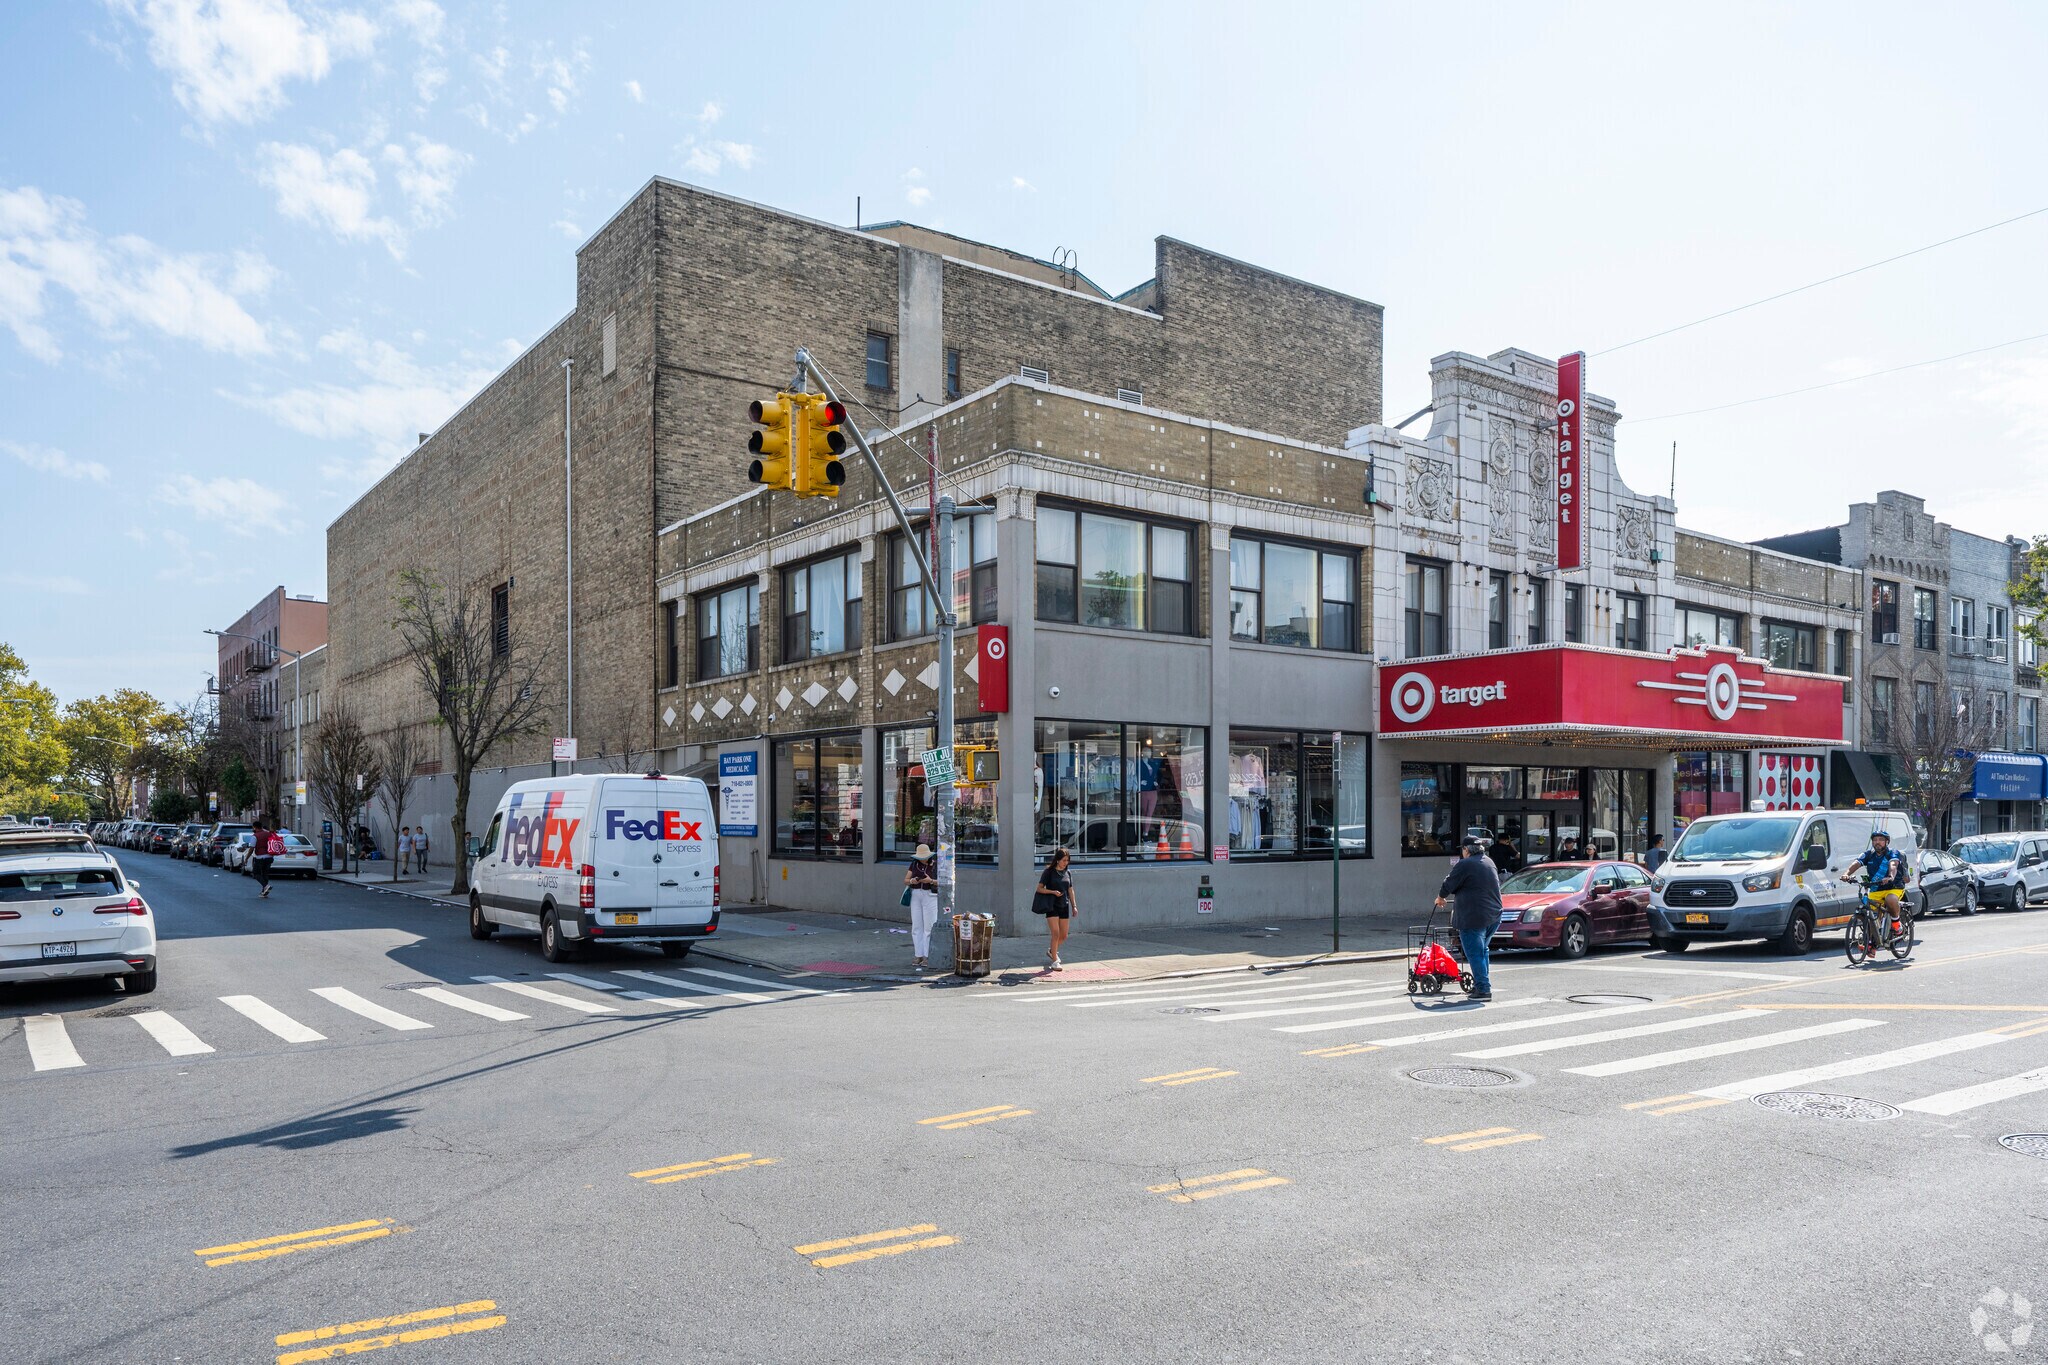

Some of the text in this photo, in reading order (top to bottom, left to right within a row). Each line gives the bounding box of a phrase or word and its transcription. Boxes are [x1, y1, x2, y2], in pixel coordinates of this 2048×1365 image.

[1559, 421, 1573, 524] target
[1440, 680, 1507, 707] target
[923, 751, 938, 763] GOT
[927, 767, 940, 776] 929
[501, 791, 581, 870] FedEx
[606, 810, 703, 841] FedEx
[666, 843, 702, 854] Express
[537, 871, 559, 891] Express
[676, 885, 708, 893] fedex.com
[1199, 901, 1212, 911] FDC
